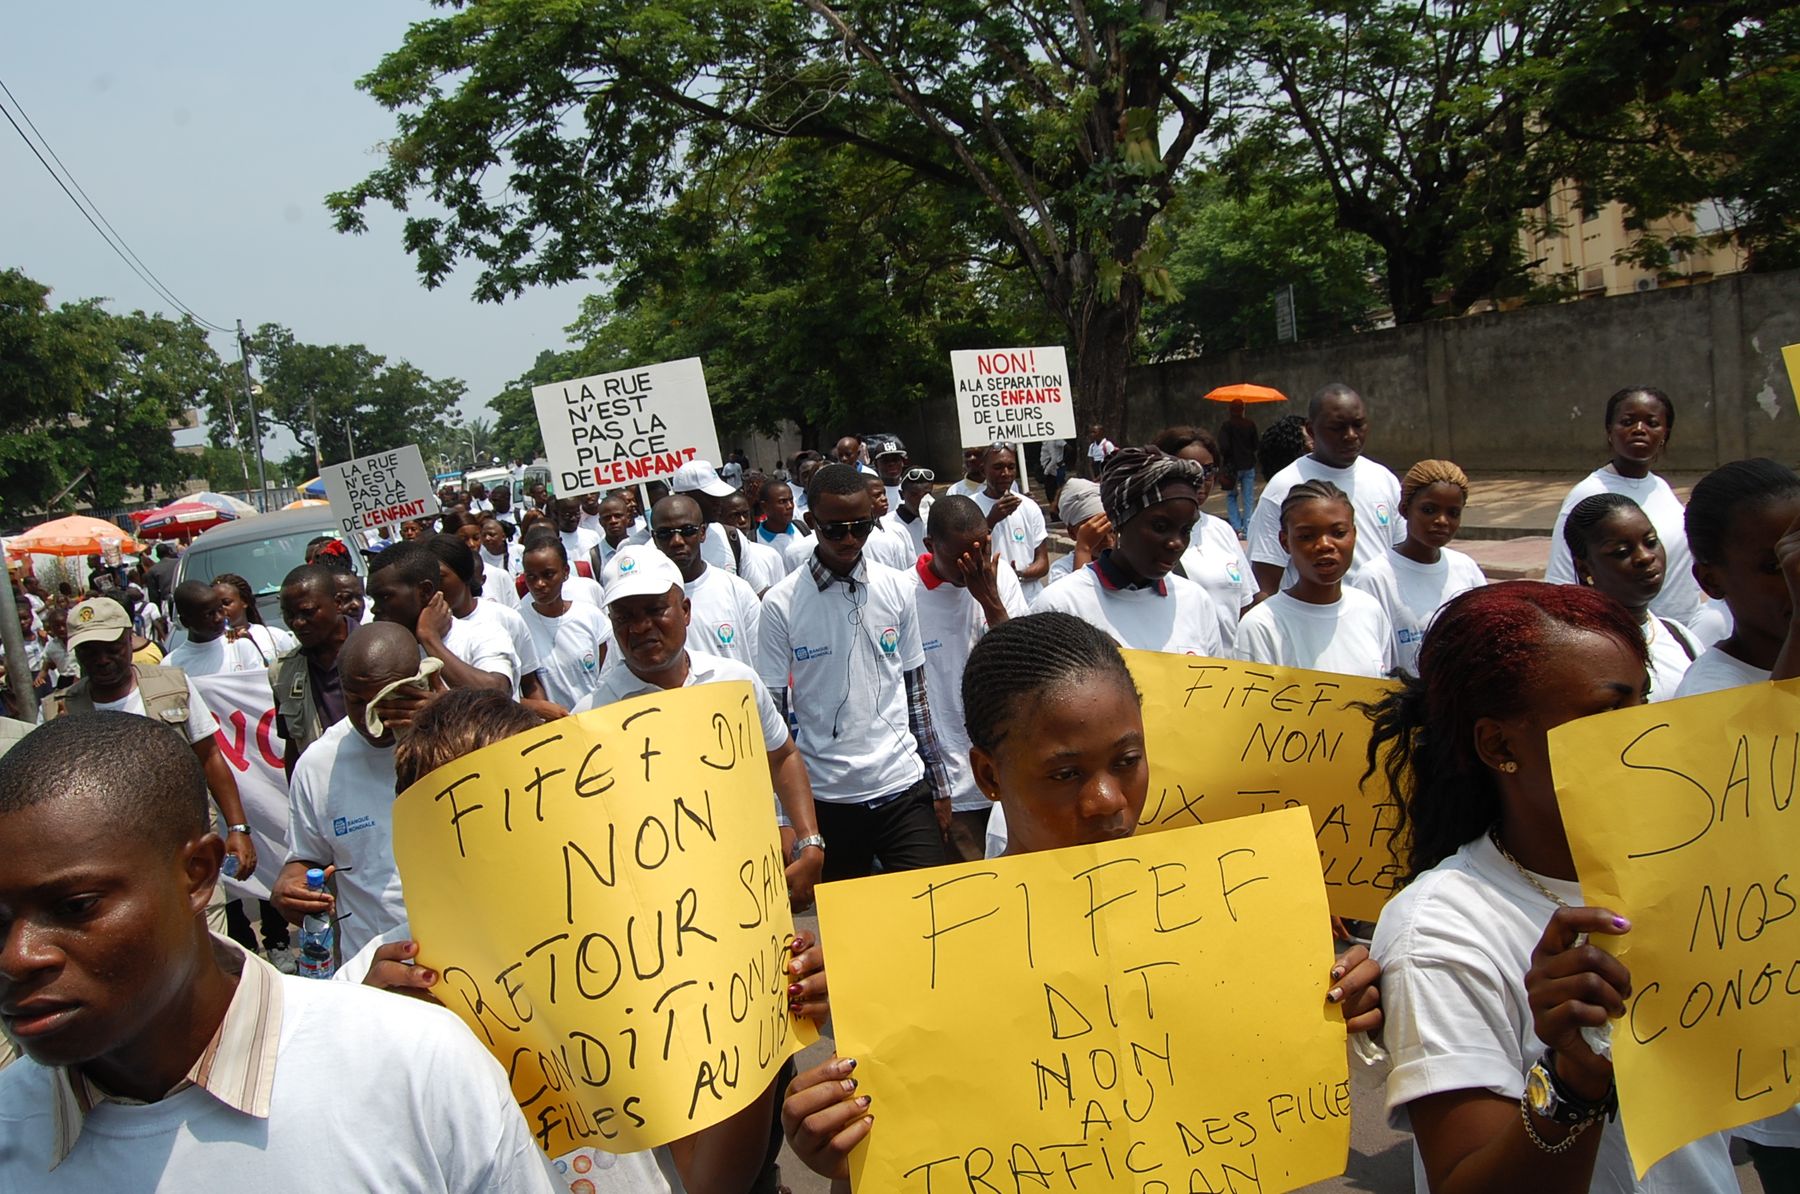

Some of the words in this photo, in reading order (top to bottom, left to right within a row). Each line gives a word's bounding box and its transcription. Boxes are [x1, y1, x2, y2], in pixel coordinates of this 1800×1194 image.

[977, 350, 1036, 375] NON!
[564, 384, 596, 405] LA
[603, 372, 653, 398] RUE
[972, 394, 1000, 408] DES
[1001, 388, 1062, 407] ENFANTS
[987, 375, 1062, 391] SEPARATION
[568, 394, 648, 425] N'EST
[974, 410, 992, 424] DE
[996, 407, 1043, 423] LEURS
[572, 421, 624, 446] PAS
[633, 413, 667, 436] LA
[988, 421, 1055, 441] FAMILLES
[341, 464, 362, 479] LA
[367, 453, 398, 471] RUE
[577, 434, 669, 467] PLACE
[345, 467, 397, 490] N'EST
[561, 469, 595, 491] DE
[594, 447, 697, 487] L'ENFANT
[349, 485, 381, 502] PAS
[385, 479, 406, 493] LA
[352, 490, 408, 514] PLACE
[342, 515, 362, 532] DE
[362, 499, 425, 528] L'ENFANT
[1184, 664, 1340, 716] FIFEF
[1240, 722, 1343, 763] NON
[562, 790, 717, 924] NON
[912, 848, 1269, 989] FIFEF
[1689, 873, 1797, 953] NOS
[443, 887, 718, 1047] RETOUR
[739, 843, 788, 929] SAN
[1044, 961, 1181, 1041] DIT
[688, 1044, 740, 1120] AU
[1030, 1032, 1176, 1112] NON
[1081, 1078, 1156, 1141] AU
[1176, 1110, 1258, 1158] DES
